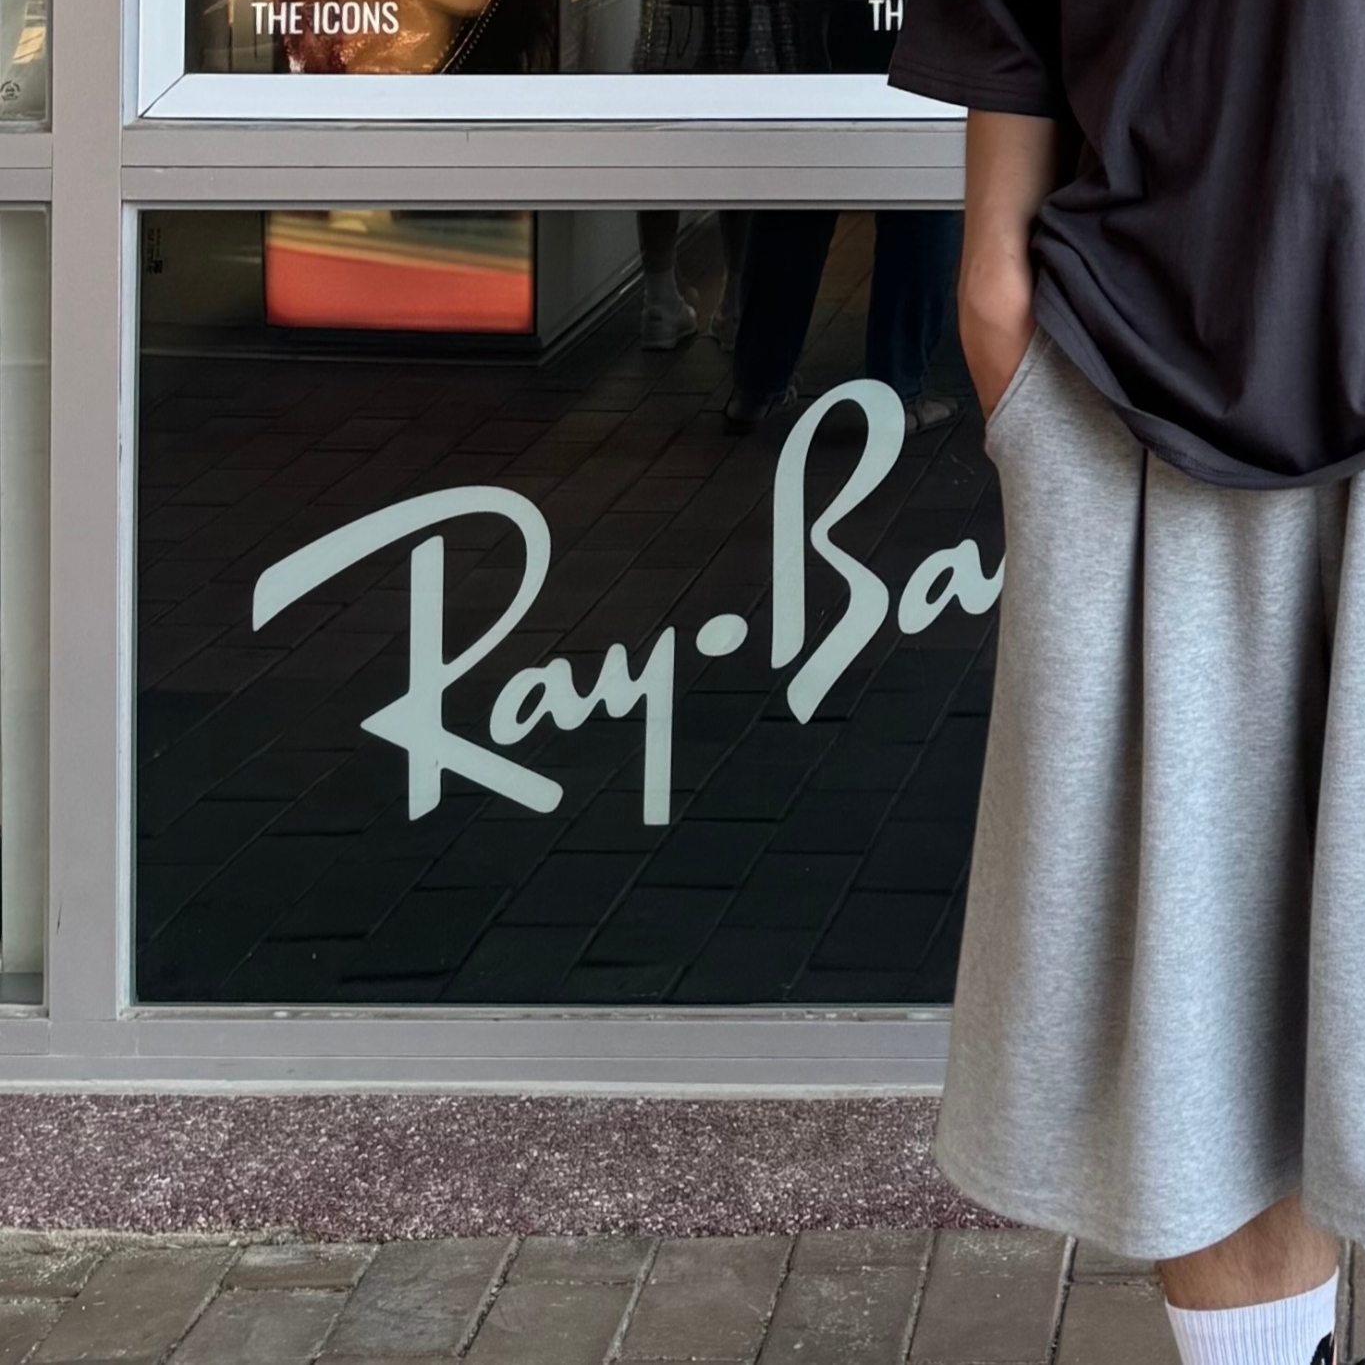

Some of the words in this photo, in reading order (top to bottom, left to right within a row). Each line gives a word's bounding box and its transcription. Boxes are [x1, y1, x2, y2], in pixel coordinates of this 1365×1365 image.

[250, 1, 305, 35] THE
[313, 1, 400, 35] ICONS
[252, 379, 1006, 826] Ray-Ba
